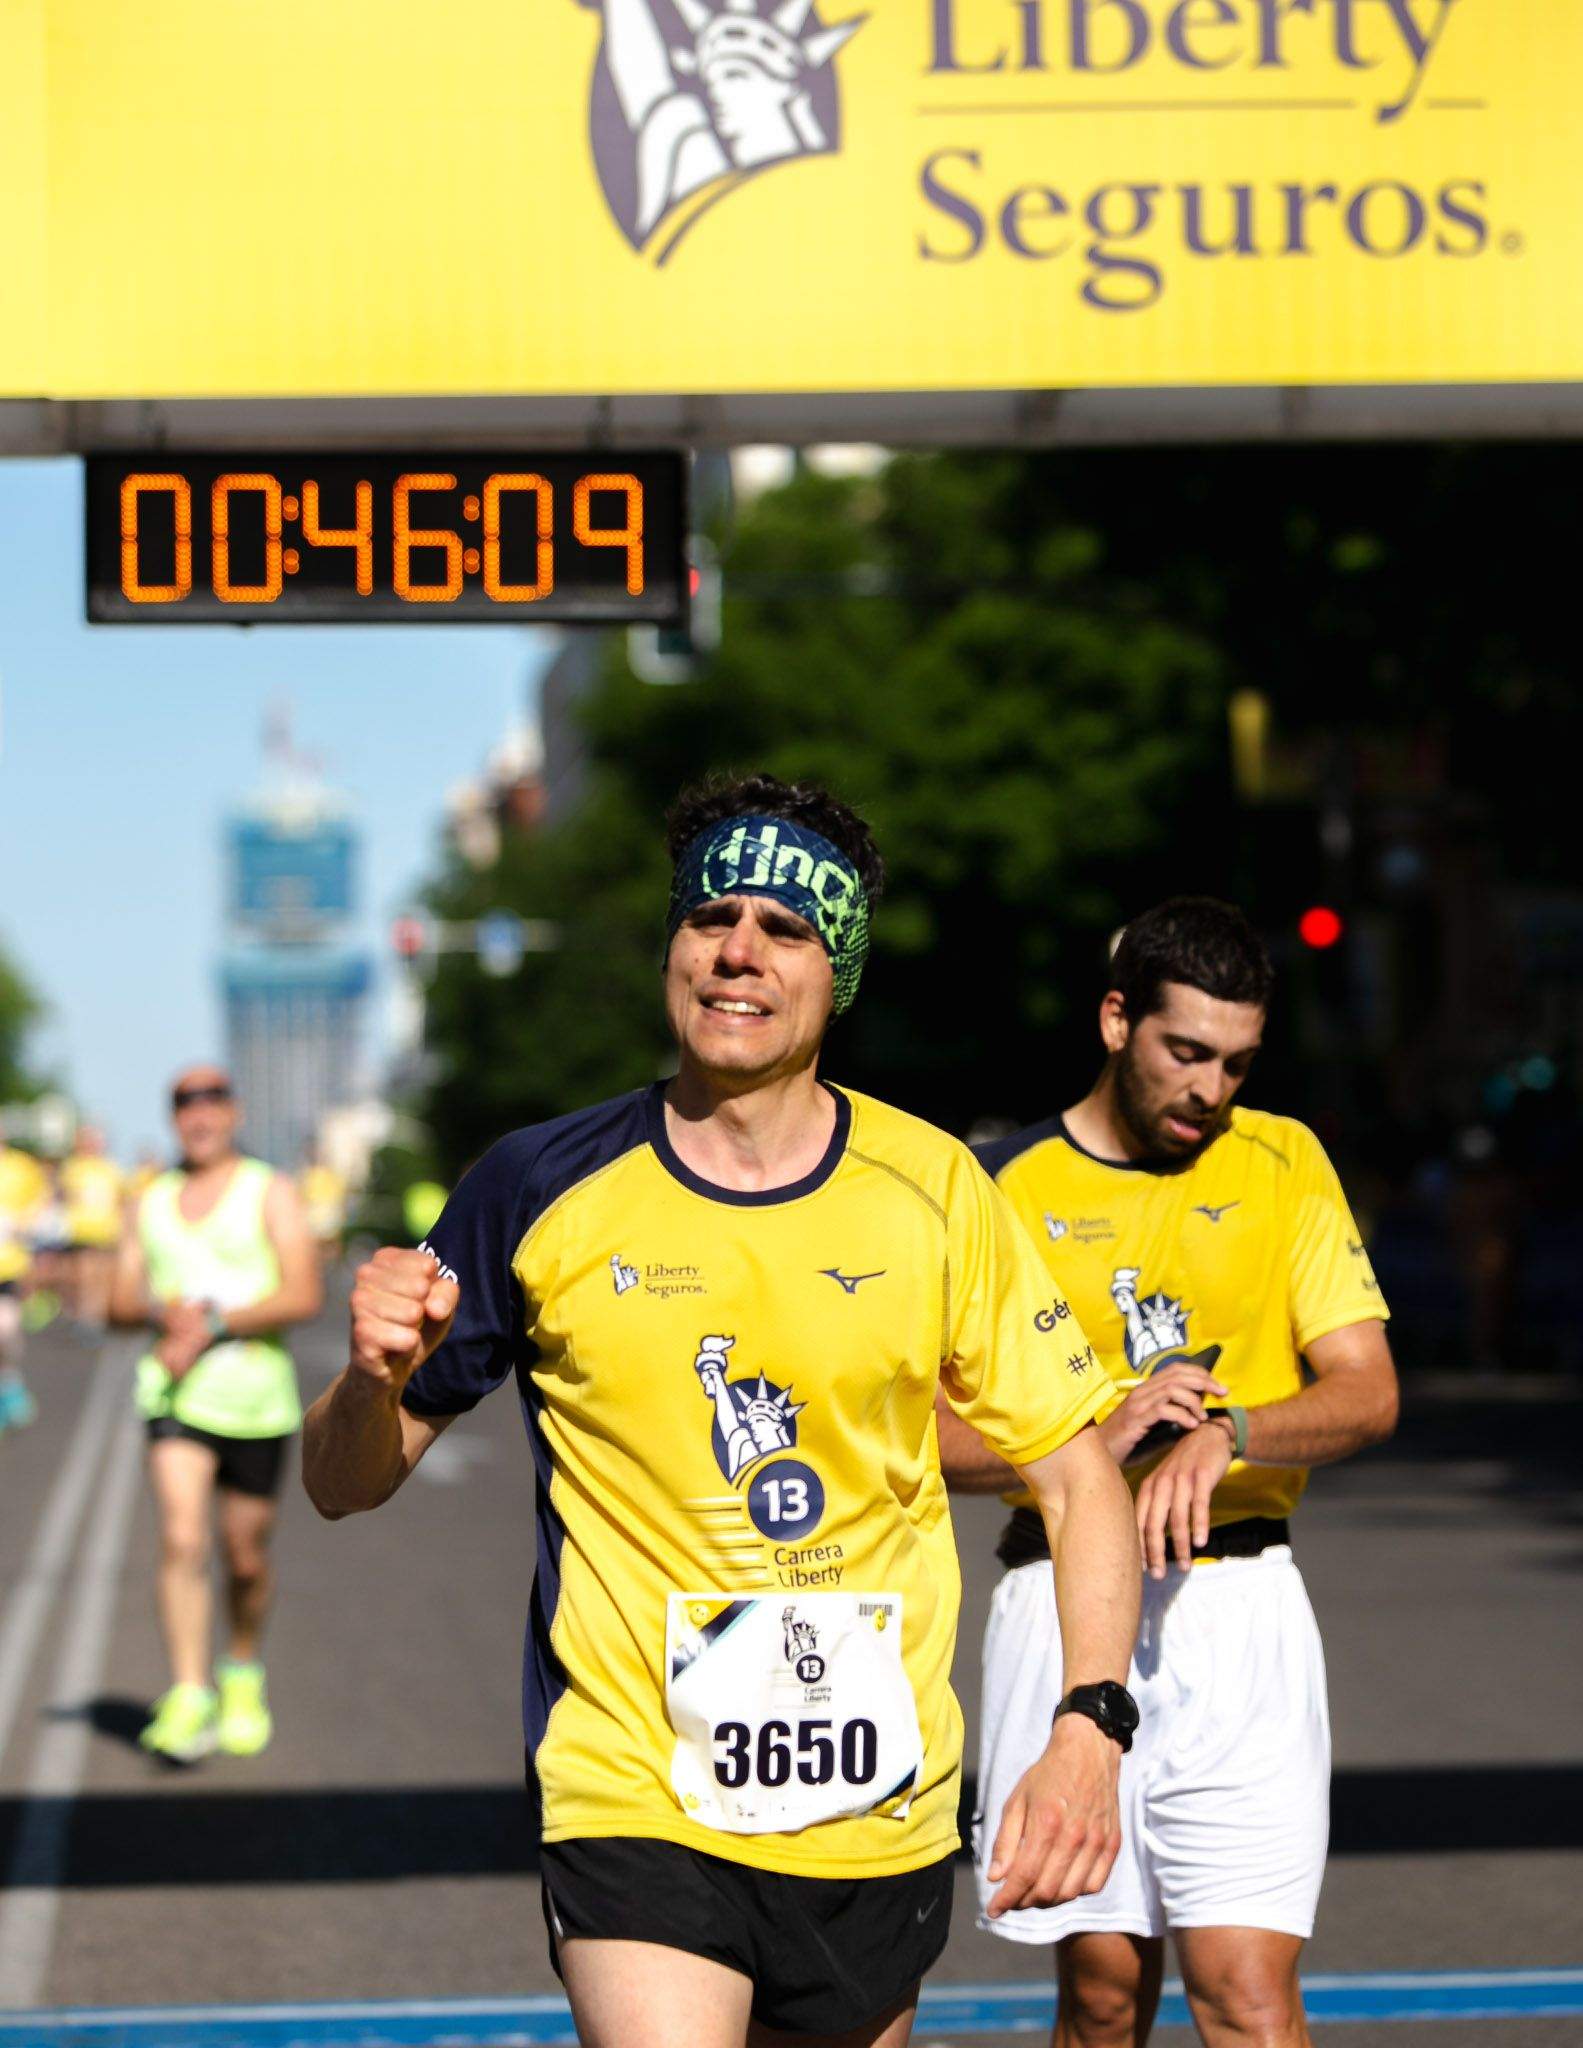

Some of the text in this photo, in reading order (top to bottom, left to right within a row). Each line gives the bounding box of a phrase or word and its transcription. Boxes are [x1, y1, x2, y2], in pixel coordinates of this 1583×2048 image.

[926, 0, 1452, 124] Liberty
[120, 473, 643, 603] 00:46:09
[646, 1263, 700, 1281] Liberty
[762, 1477, 810, 1523] 13
[774, 1543, 844, 1566] Carrera
[778, 1565, 844, 1588] Liberty
[801, 1659, 821, 1679] 13
[714, 1717, 878, 1789] 3650
